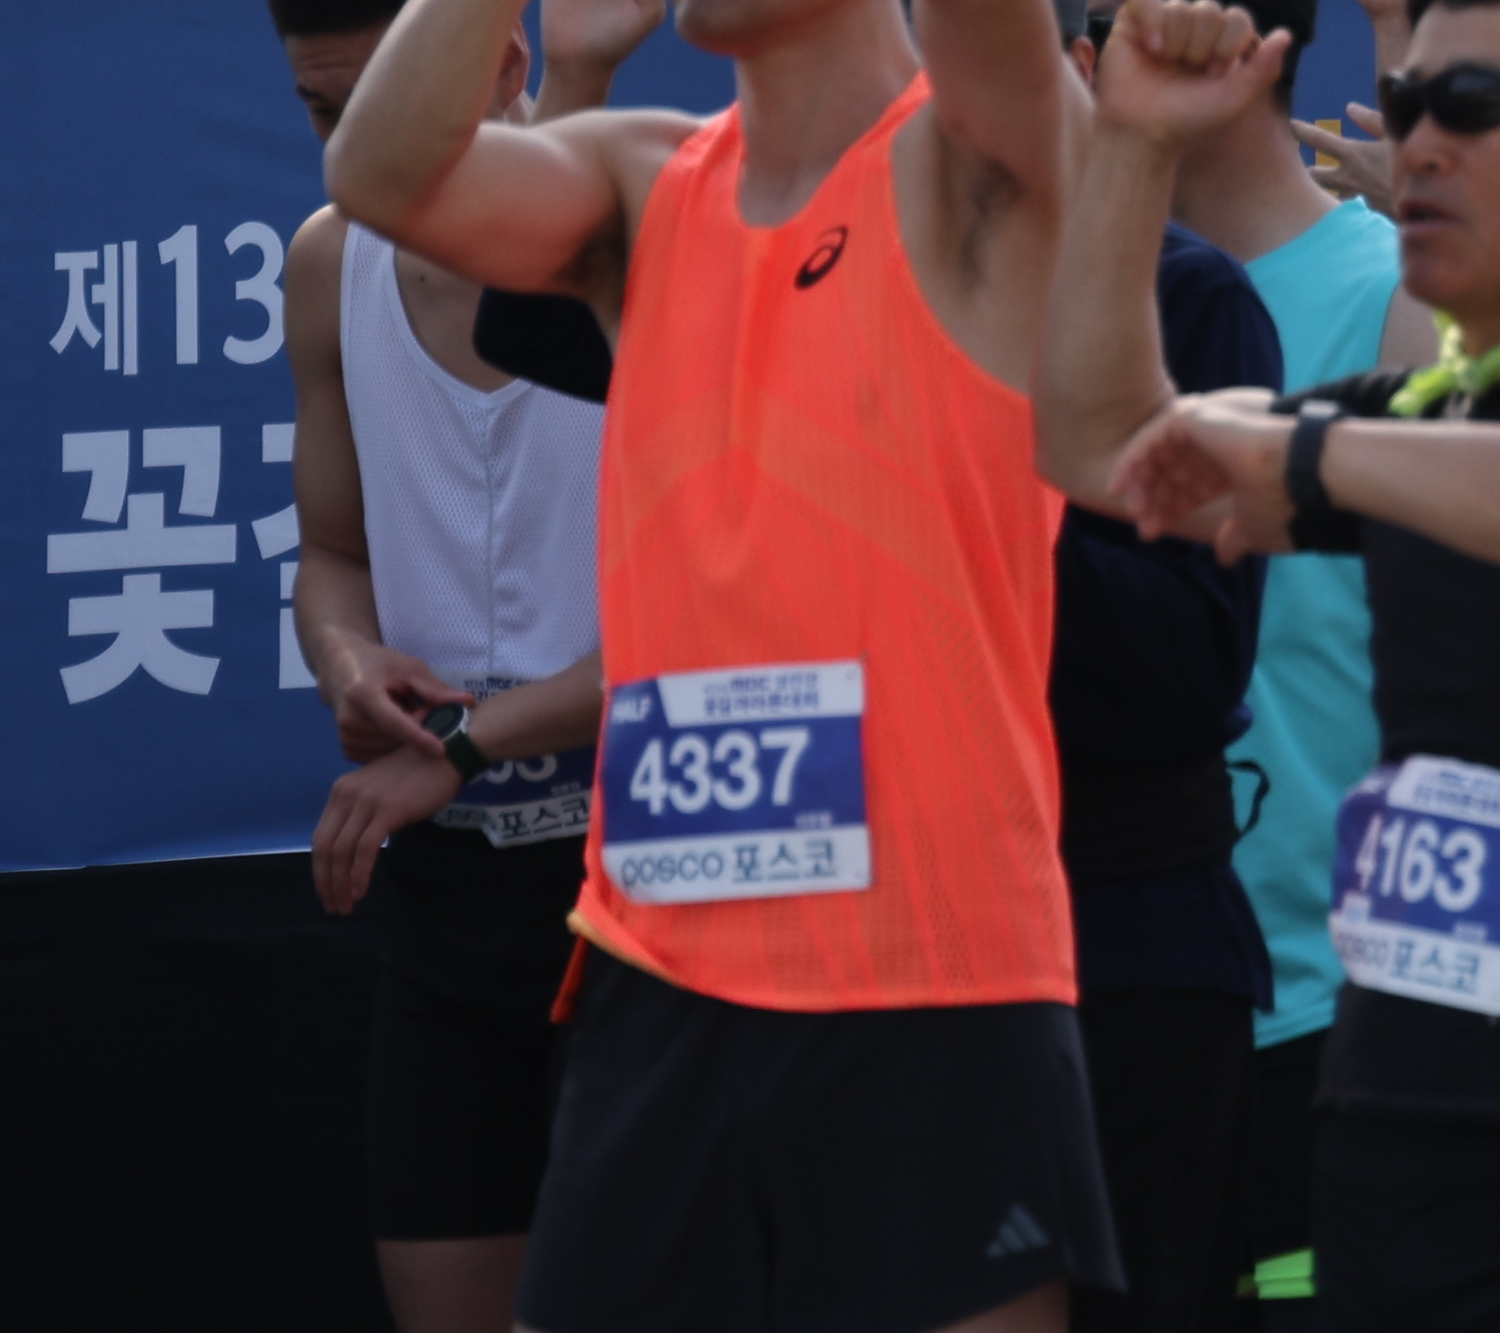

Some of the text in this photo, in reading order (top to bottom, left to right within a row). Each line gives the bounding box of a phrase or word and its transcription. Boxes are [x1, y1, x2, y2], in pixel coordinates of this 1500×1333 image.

[628, 726, 812, 815] 4337
[499, 798, 588, 840] 포스코
[732, 839, 837, 886] 포스코
[1354, 814, 1486, 913] 4163
[1392, 938, 1480, 995] 포스코
